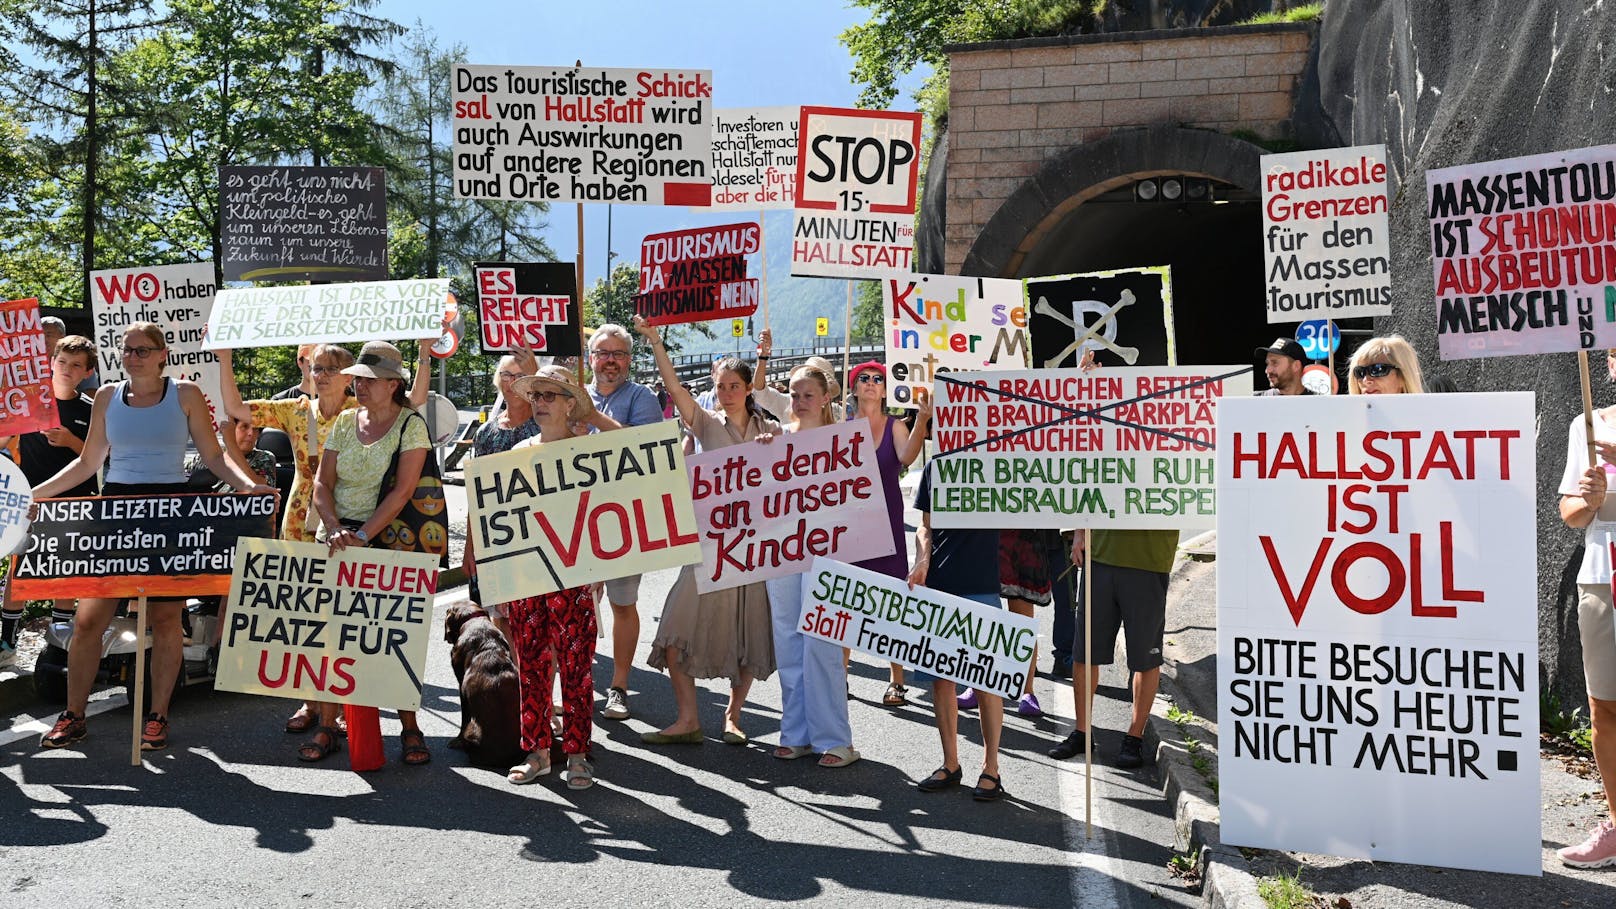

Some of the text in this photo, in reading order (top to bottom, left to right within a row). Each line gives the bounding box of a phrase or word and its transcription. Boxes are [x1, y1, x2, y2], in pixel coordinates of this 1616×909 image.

[457, 68, 712, 98] Das touristische Schick-
[456, 94, 702, 125] sal von Hallstatt wird
[717, 115, 783, 133] Investoren
[457, 122, 683, 159] auch Auswirkungen
[458, 146, 705, 183] auf andere Regionen
[711, 150, 774, 168] Hallstatt
[807, 134, 914, 185] STOP
[225, 169, 375, 195] es geht uns nicht
[458, 173, 647, 202] und Orte haben
[765, 166, 787, 187] für
[1267, 156, 1386, 193] radikale
[226, 187, 348, 209] um politisches
[715, 186, 749, 204] aber
[754, 184, 778, 202] die
[1267, 193, 1388, 222] Grenzen
[338, 202, 377, 221] geht
[226, 223, 254, 235] um
[261, 222, 326, 235] unseren
[227, 234, 273, 247] raum
[795, 216, 913, 243] MINUTEN FÜR
[1267, 220, 1373, 253] für den
[1433, 219, 1473, 259] IST
[227, 245, 295, 268] Zukunft
[300, 251, 328, 264] und
[643, 226, 758, 265] TOURISMUS
[793, 241, 913, 269] HALLSTATT
[164, 278, 216, 301] haben
[319, 288, 346, 304] IST
[354, 285, 386, 301] DER
[479, 270, 515, 295] ES
[720, 280, 758, 310] NEIN
[98, 306, 130, 327] sich
[136, 304, 159, 324] die
[219, 305, 268, 325] BOTE
[276, 303, 313, 322] DER
[481, 296, 571, 323] REICHT
[1438, 289, 1569, 334] MENSCH
[214, 313, 442, 342] EN SELBSTZERSTÖRUNG
[483, 324, 546, 350] UNS
[892, 320, 919, 350] in
[929, 323, 982, 353] der
[1303, 324, 1330, 352] 30
[945, 375, 1223, 403] WIR BRAUCHEN BETTEN
[936, 399, 1216, 428] WIR BRAUCHEN PARKPLÄ
[937, 430, 978, 453] WIR
[987, 427, 1104, 452] BRAUCHEN
[692, 432, 864, 500] bitte denkt
[1233, 430, 1521, 482] HALLSTATT
[474, 437, 678, 509] HALLSTATT
[936, 458, 985, 484] WIR
[995, 457, 1135, 485] BRAUCHEN
[101, 498, 182, 520] LETZTER
[189, 495, 275, 517] AUSWEG
[709, 476, 872, 530] an unsere
[933, 487, 1216, 518] LEBENSRAUM, RESPE
[1327, 484, 1409, 534] IST
[66, 527, 167, 552] Touristen
[178, 526, 214, 548] mit
[479, 490, 700, 568] IST VOLL
[706, 518, 847, 582] Kinder
[17, 553, 150, 577] Aktionismus
[243, 552, 438, 594] KEINE NEUEN
[1258, 521, 1485, 628] VOLL
[238, 581, 426, 624] PARKPLÄTZE
[802, 604, 852, 641] statt
[228, 612, 418, 677] PLATZ FÜR
[257, 650, 356, 696] UNS
[1234, 637, 1524, 692] BITTE BESUCHEN
[1230, 679, 1522, 738] SIE UNS HEUTE
[1234, 720, 1337, 766] NICHT
